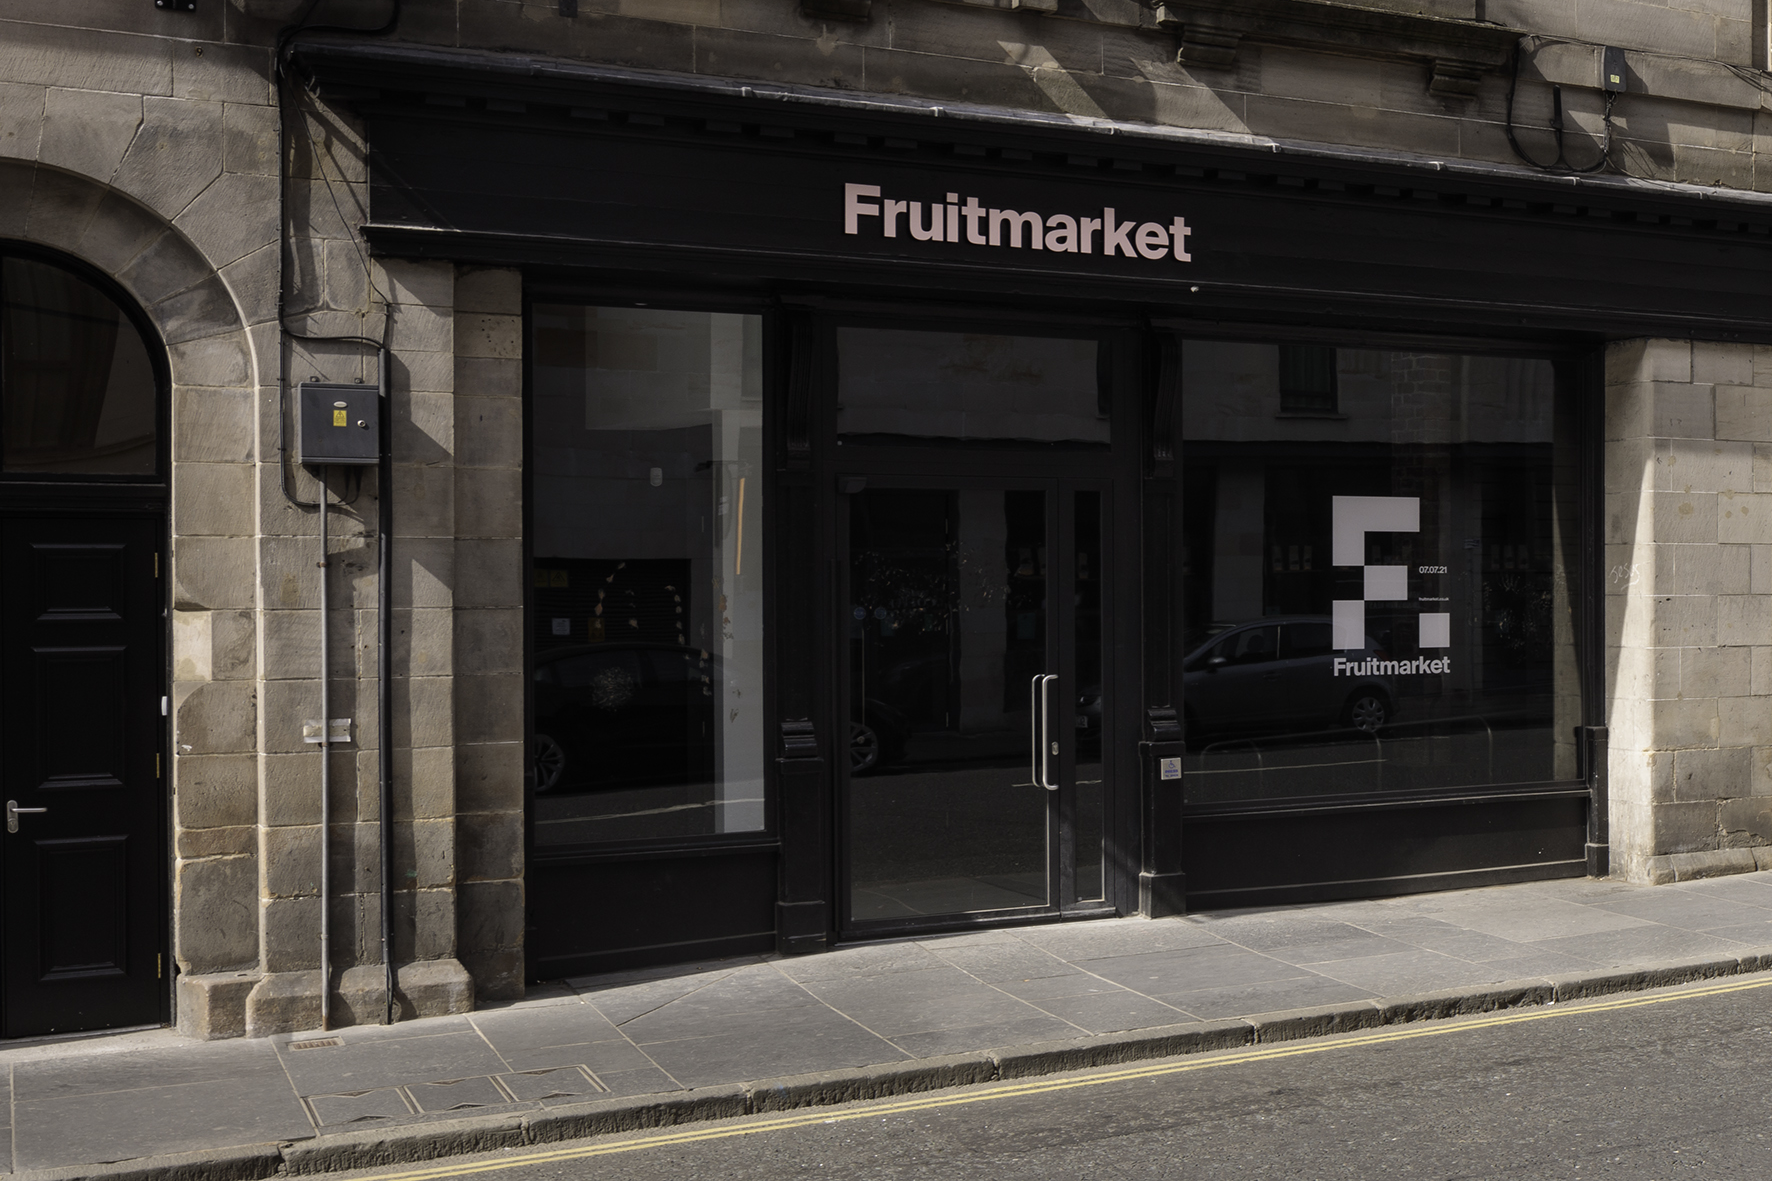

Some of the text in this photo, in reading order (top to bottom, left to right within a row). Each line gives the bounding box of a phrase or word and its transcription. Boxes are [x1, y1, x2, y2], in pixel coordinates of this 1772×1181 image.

[845, 182, 1192, 263] Fruitmarket
[1418, 566, 1448, 574] 07.07.21
[1333, 656, 1451, 676] Fruitmarket
